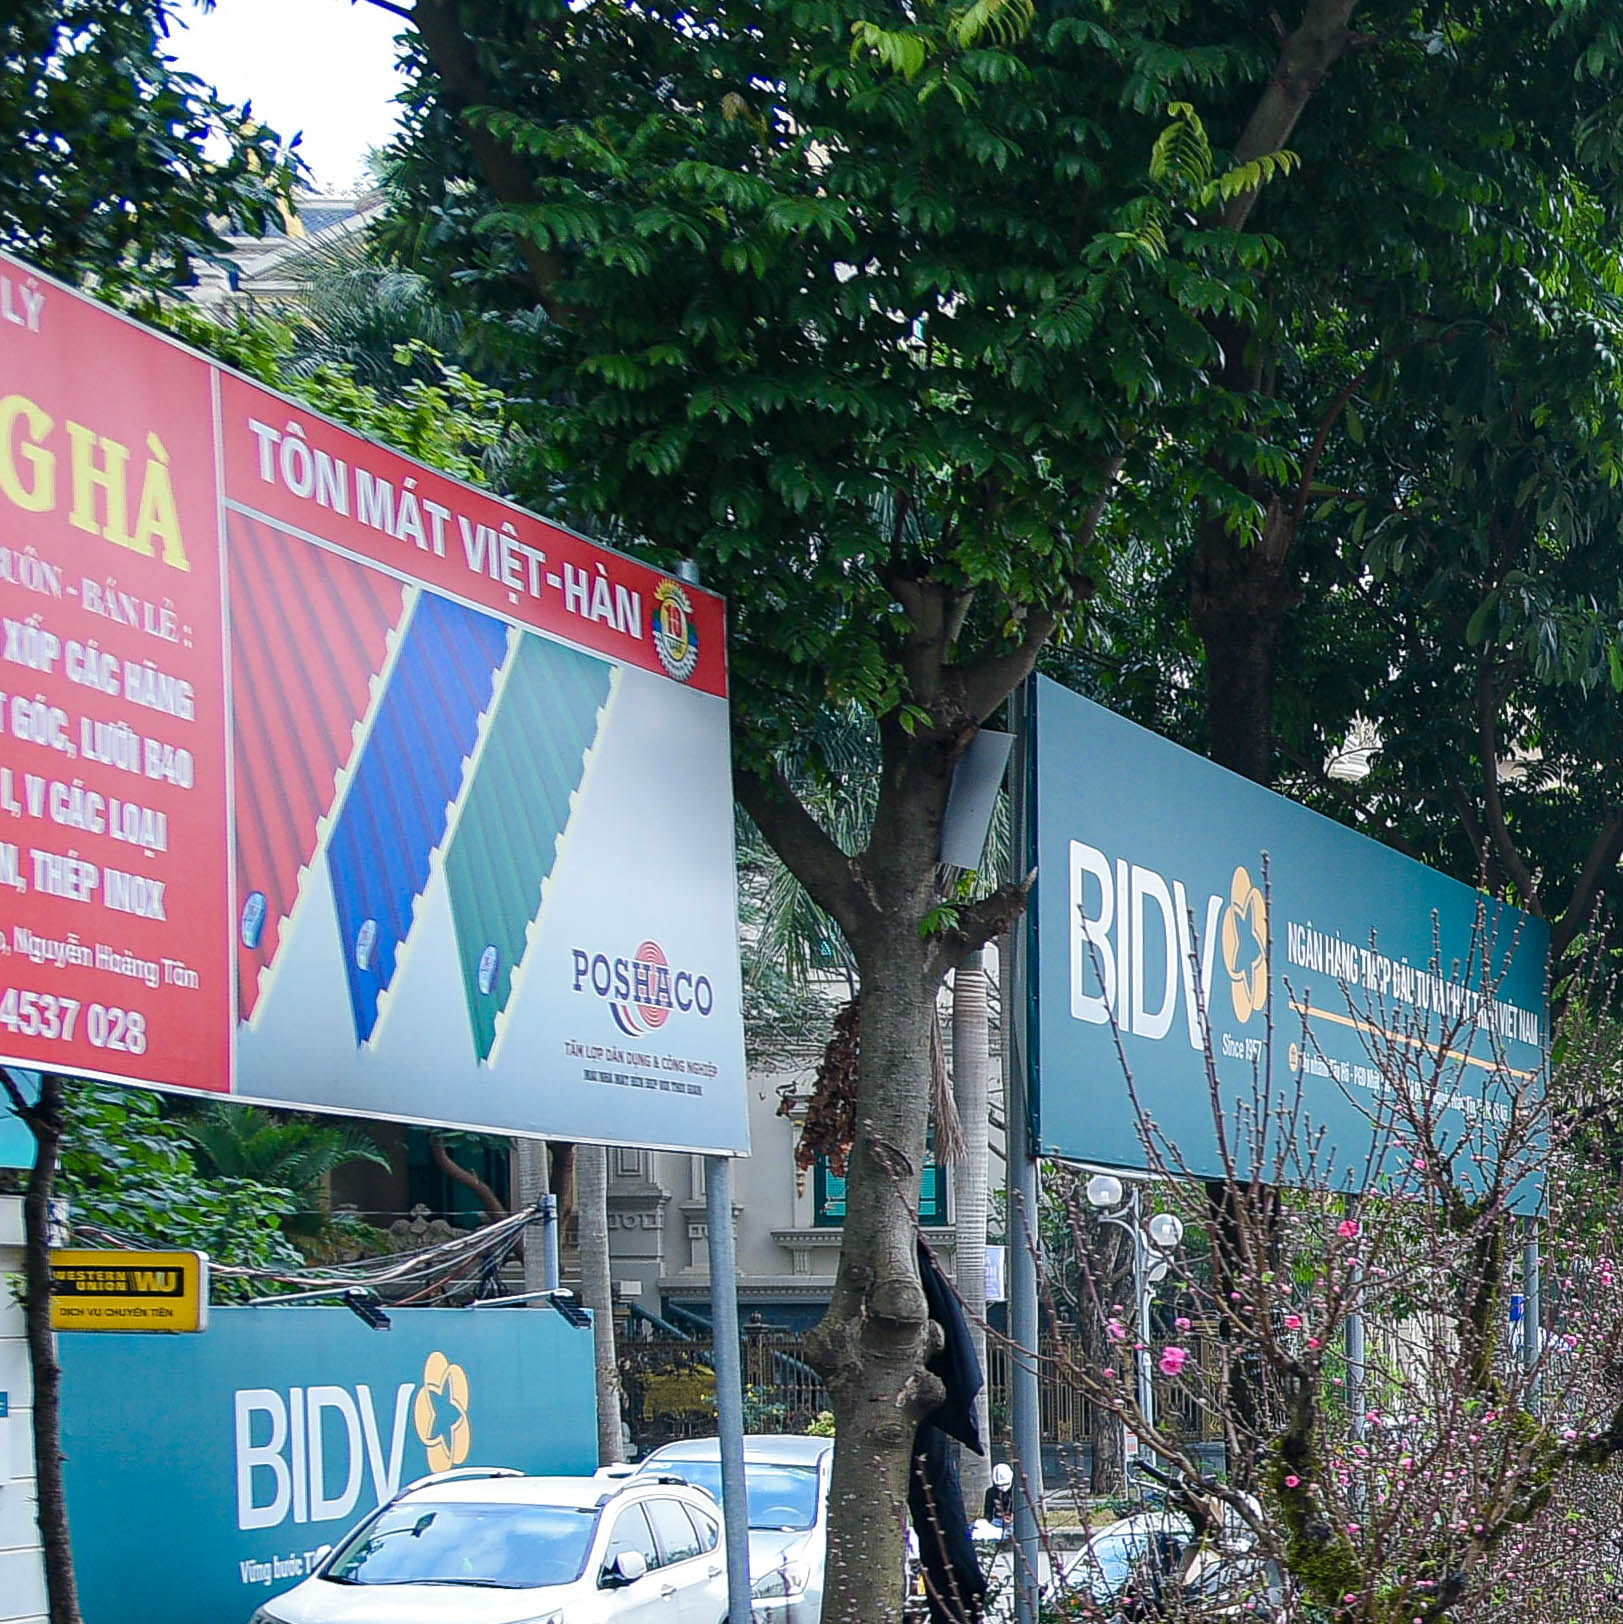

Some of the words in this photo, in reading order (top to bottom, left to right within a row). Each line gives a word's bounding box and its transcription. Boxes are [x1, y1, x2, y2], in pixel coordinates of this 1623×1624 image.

[248, 418, 348, 517] TÔN
[355, 478, 452, 558] MÁT
[81, 575, 140, 630] BÁN
[65, 639, 121, 696] CÁC
[143, 736, 195, 790] B40
[24, 773, 46, 818] V
[49, 778, 106, 834] CÁC
[109, 797, 168, 858] LOẠI
[30, 849, 99, 904] THÉP
[104, 867, 168, 922] INOX
[13, 926, 93, 968] Nguyễn
[95, 943, 160, 988] Hoàng
[1070, 839, 1224, 1050] BIDV
[572, 947, 713, 1016] POSHACO
[1288, 920, 1323, 973] NGÂN
[1325, 931, 1358, 985] HÀNG
[1499, 998, 1518, 1043] VIỆT
[1519, 1008, 1538, 1046] NAM
[87, 1003, 147, 1055] 028
[1222, 1033, 1245, 1060] Since
[53, 1270, 128, 1281] WESTERN
[133, 1271, 178, 1293] WU
[76, 1281, 128, 1292] UNION
[235, 1383, 416, 1530] BIDV
